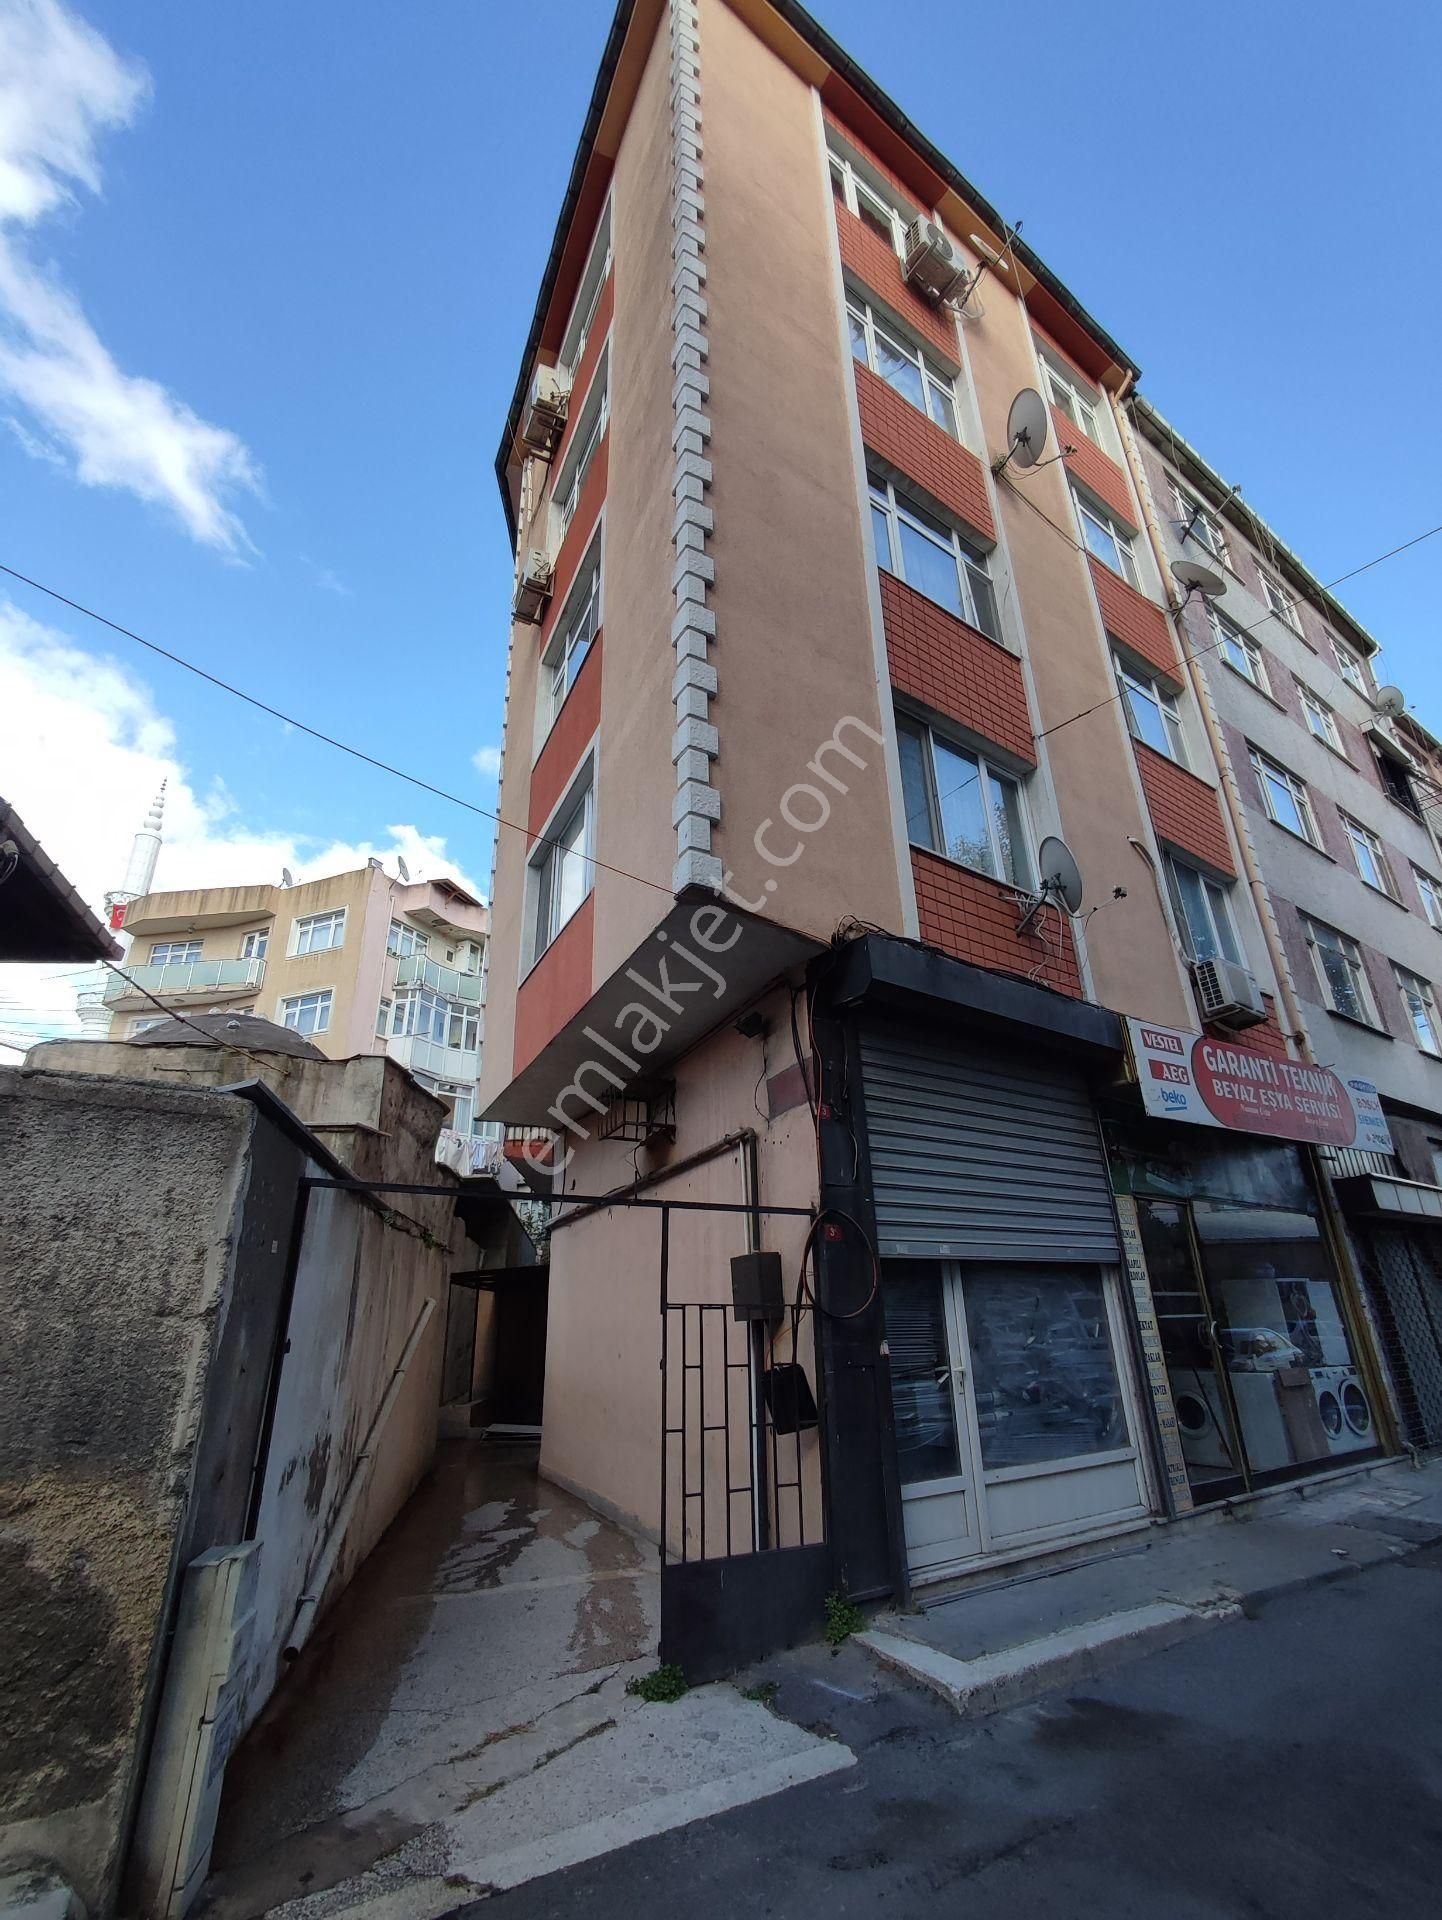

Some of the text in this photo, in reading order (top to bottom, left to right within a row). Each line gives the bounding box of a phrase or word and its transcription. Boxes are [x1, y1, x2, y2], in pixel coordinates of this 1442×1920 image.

[1143, 1031, 1182, 1053] VESTEL
[1162, 1063, 1188, 1083] AEG
[1202, 1045, 1280, 1086] GARANTİ
[1160, 1087, 1187, 1105] beko
[1212, 1079, 1258, 1104] BEYAZ
[1259, 1089, 1293, 1112] EŞYA
